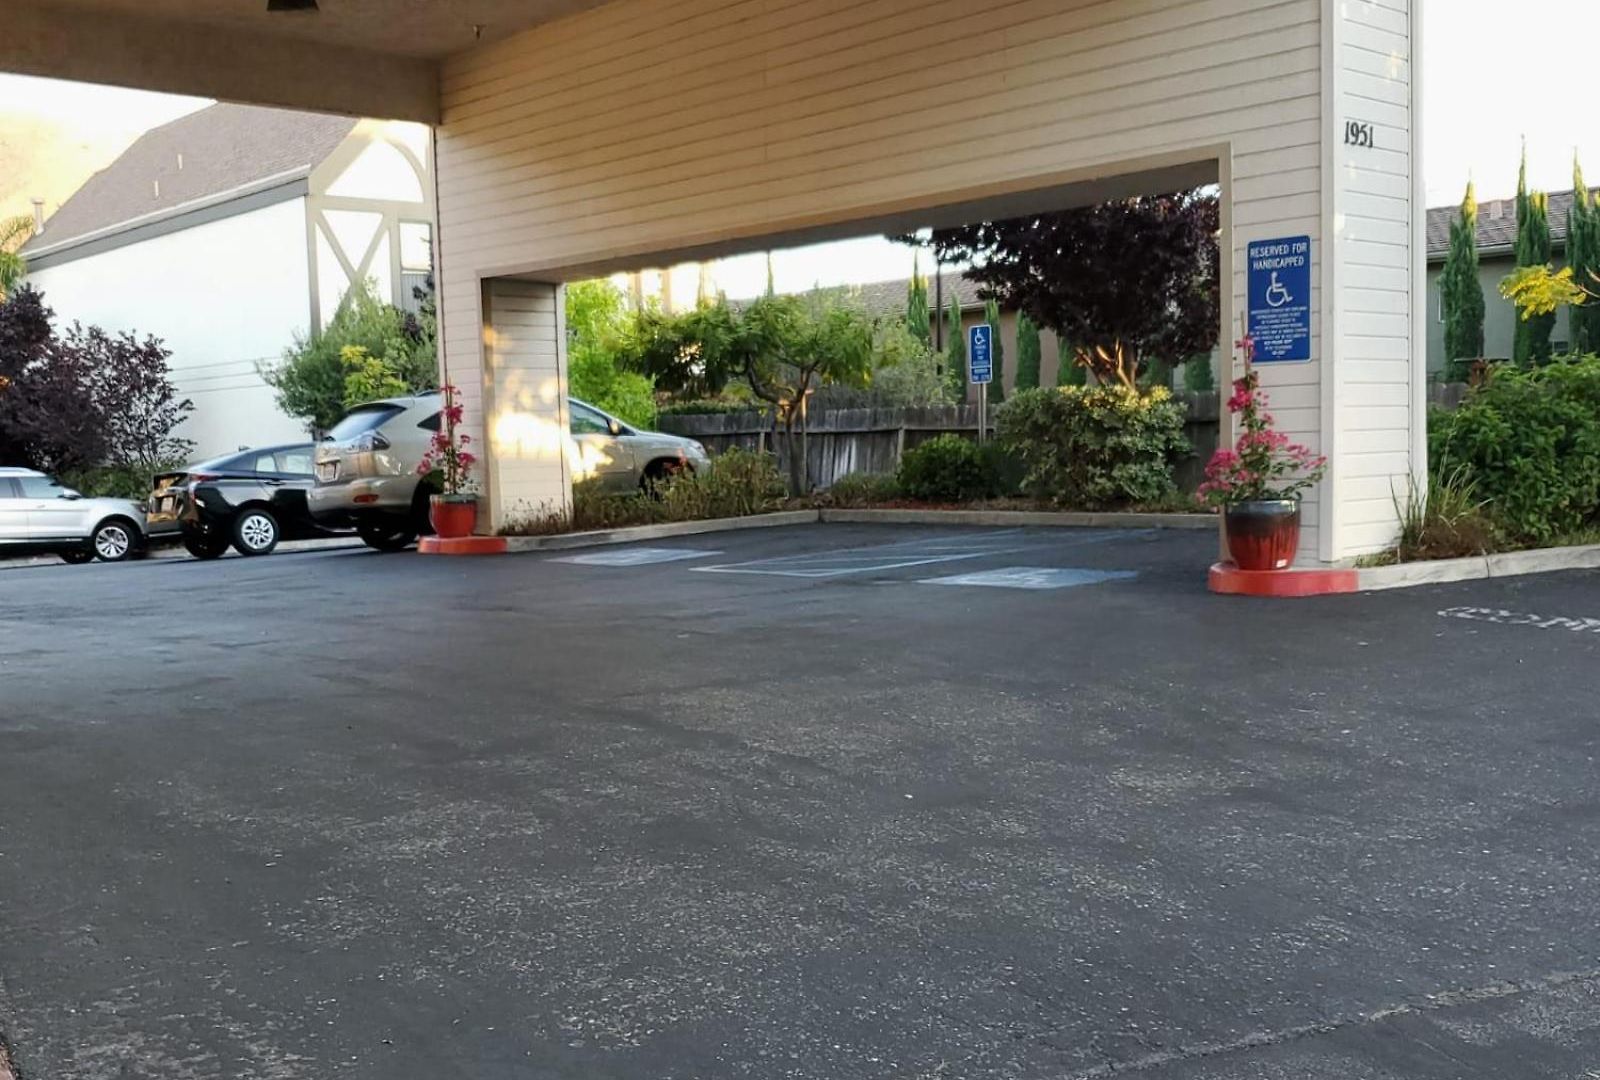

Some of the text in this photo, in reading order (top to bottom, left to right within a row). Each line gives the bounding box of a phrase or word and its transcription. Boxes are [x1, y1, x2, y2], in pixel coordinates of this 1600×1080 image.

[1344, 120, 1373, 148] 1951
[1250, 242, 1308, 258] RESERVED FOR
[1253, 256, 1304, 270] HANDICAPPED
